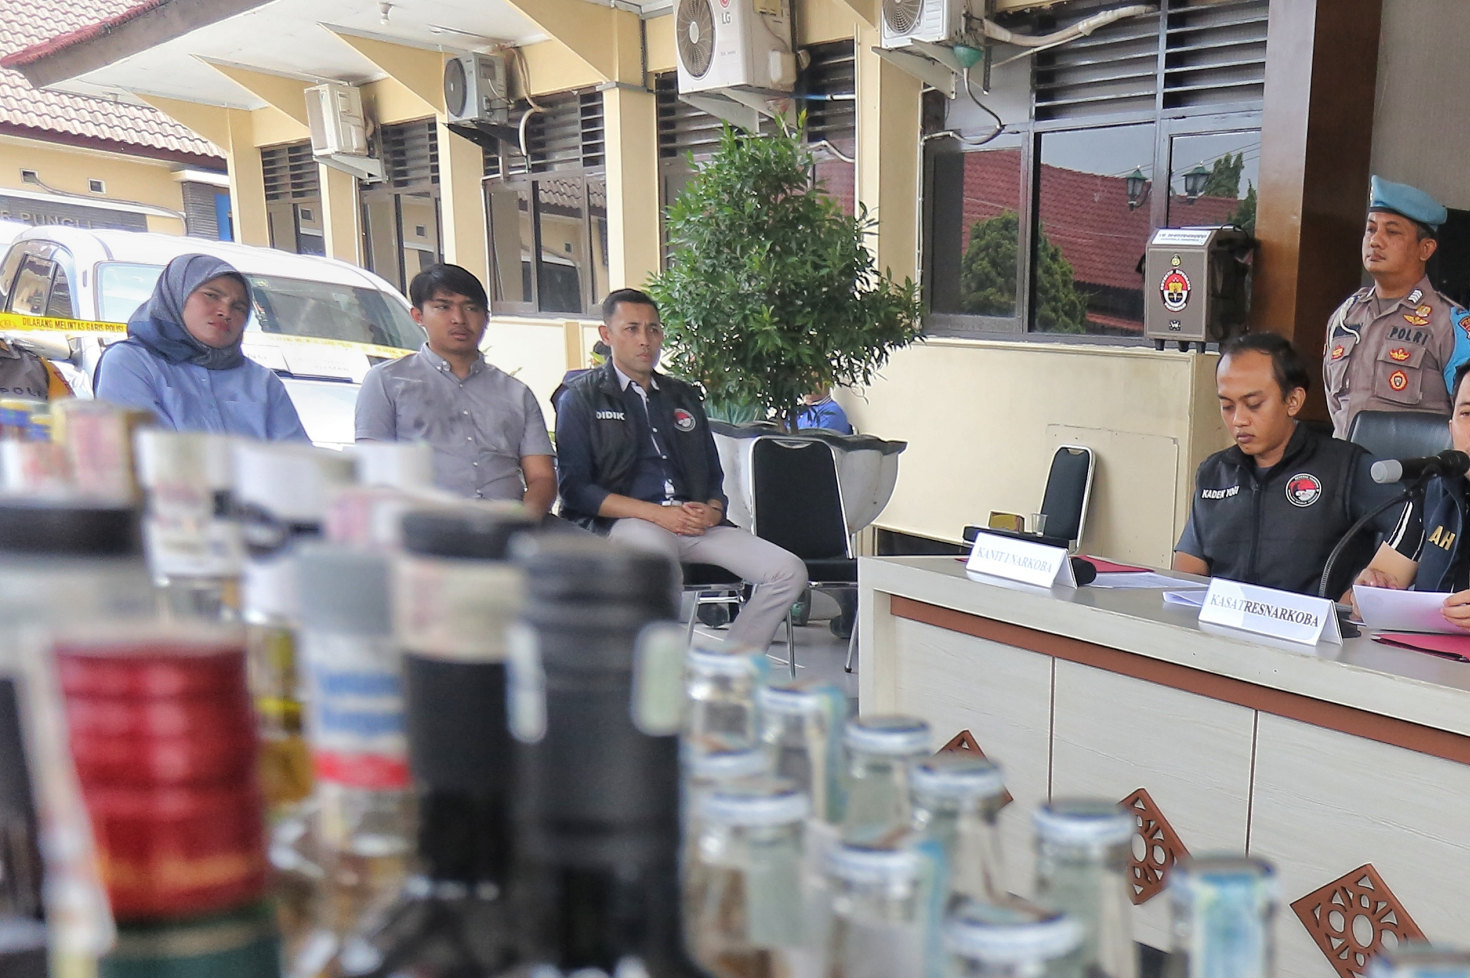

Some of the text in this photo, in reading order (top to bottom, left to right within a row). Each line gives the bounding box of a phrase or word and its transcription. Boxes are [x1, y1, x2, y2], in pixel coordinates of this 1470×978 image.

[722, 12, 731, 24] LG
[22, 317, 54, 329] DILARANG
[55, 320, 85, 331] MELINTAS
[1389, 326, 1429, 346] POLRI
[596, 411, 625, 421] DIDIK
[1202, 489, 1225, 499] KADEK
[1428, 525, 1456, 551] AH
[1012, 553, 1053, 574] NARKOBA
[1210, 593, 1320, 629] KASATRESNARKOBA
